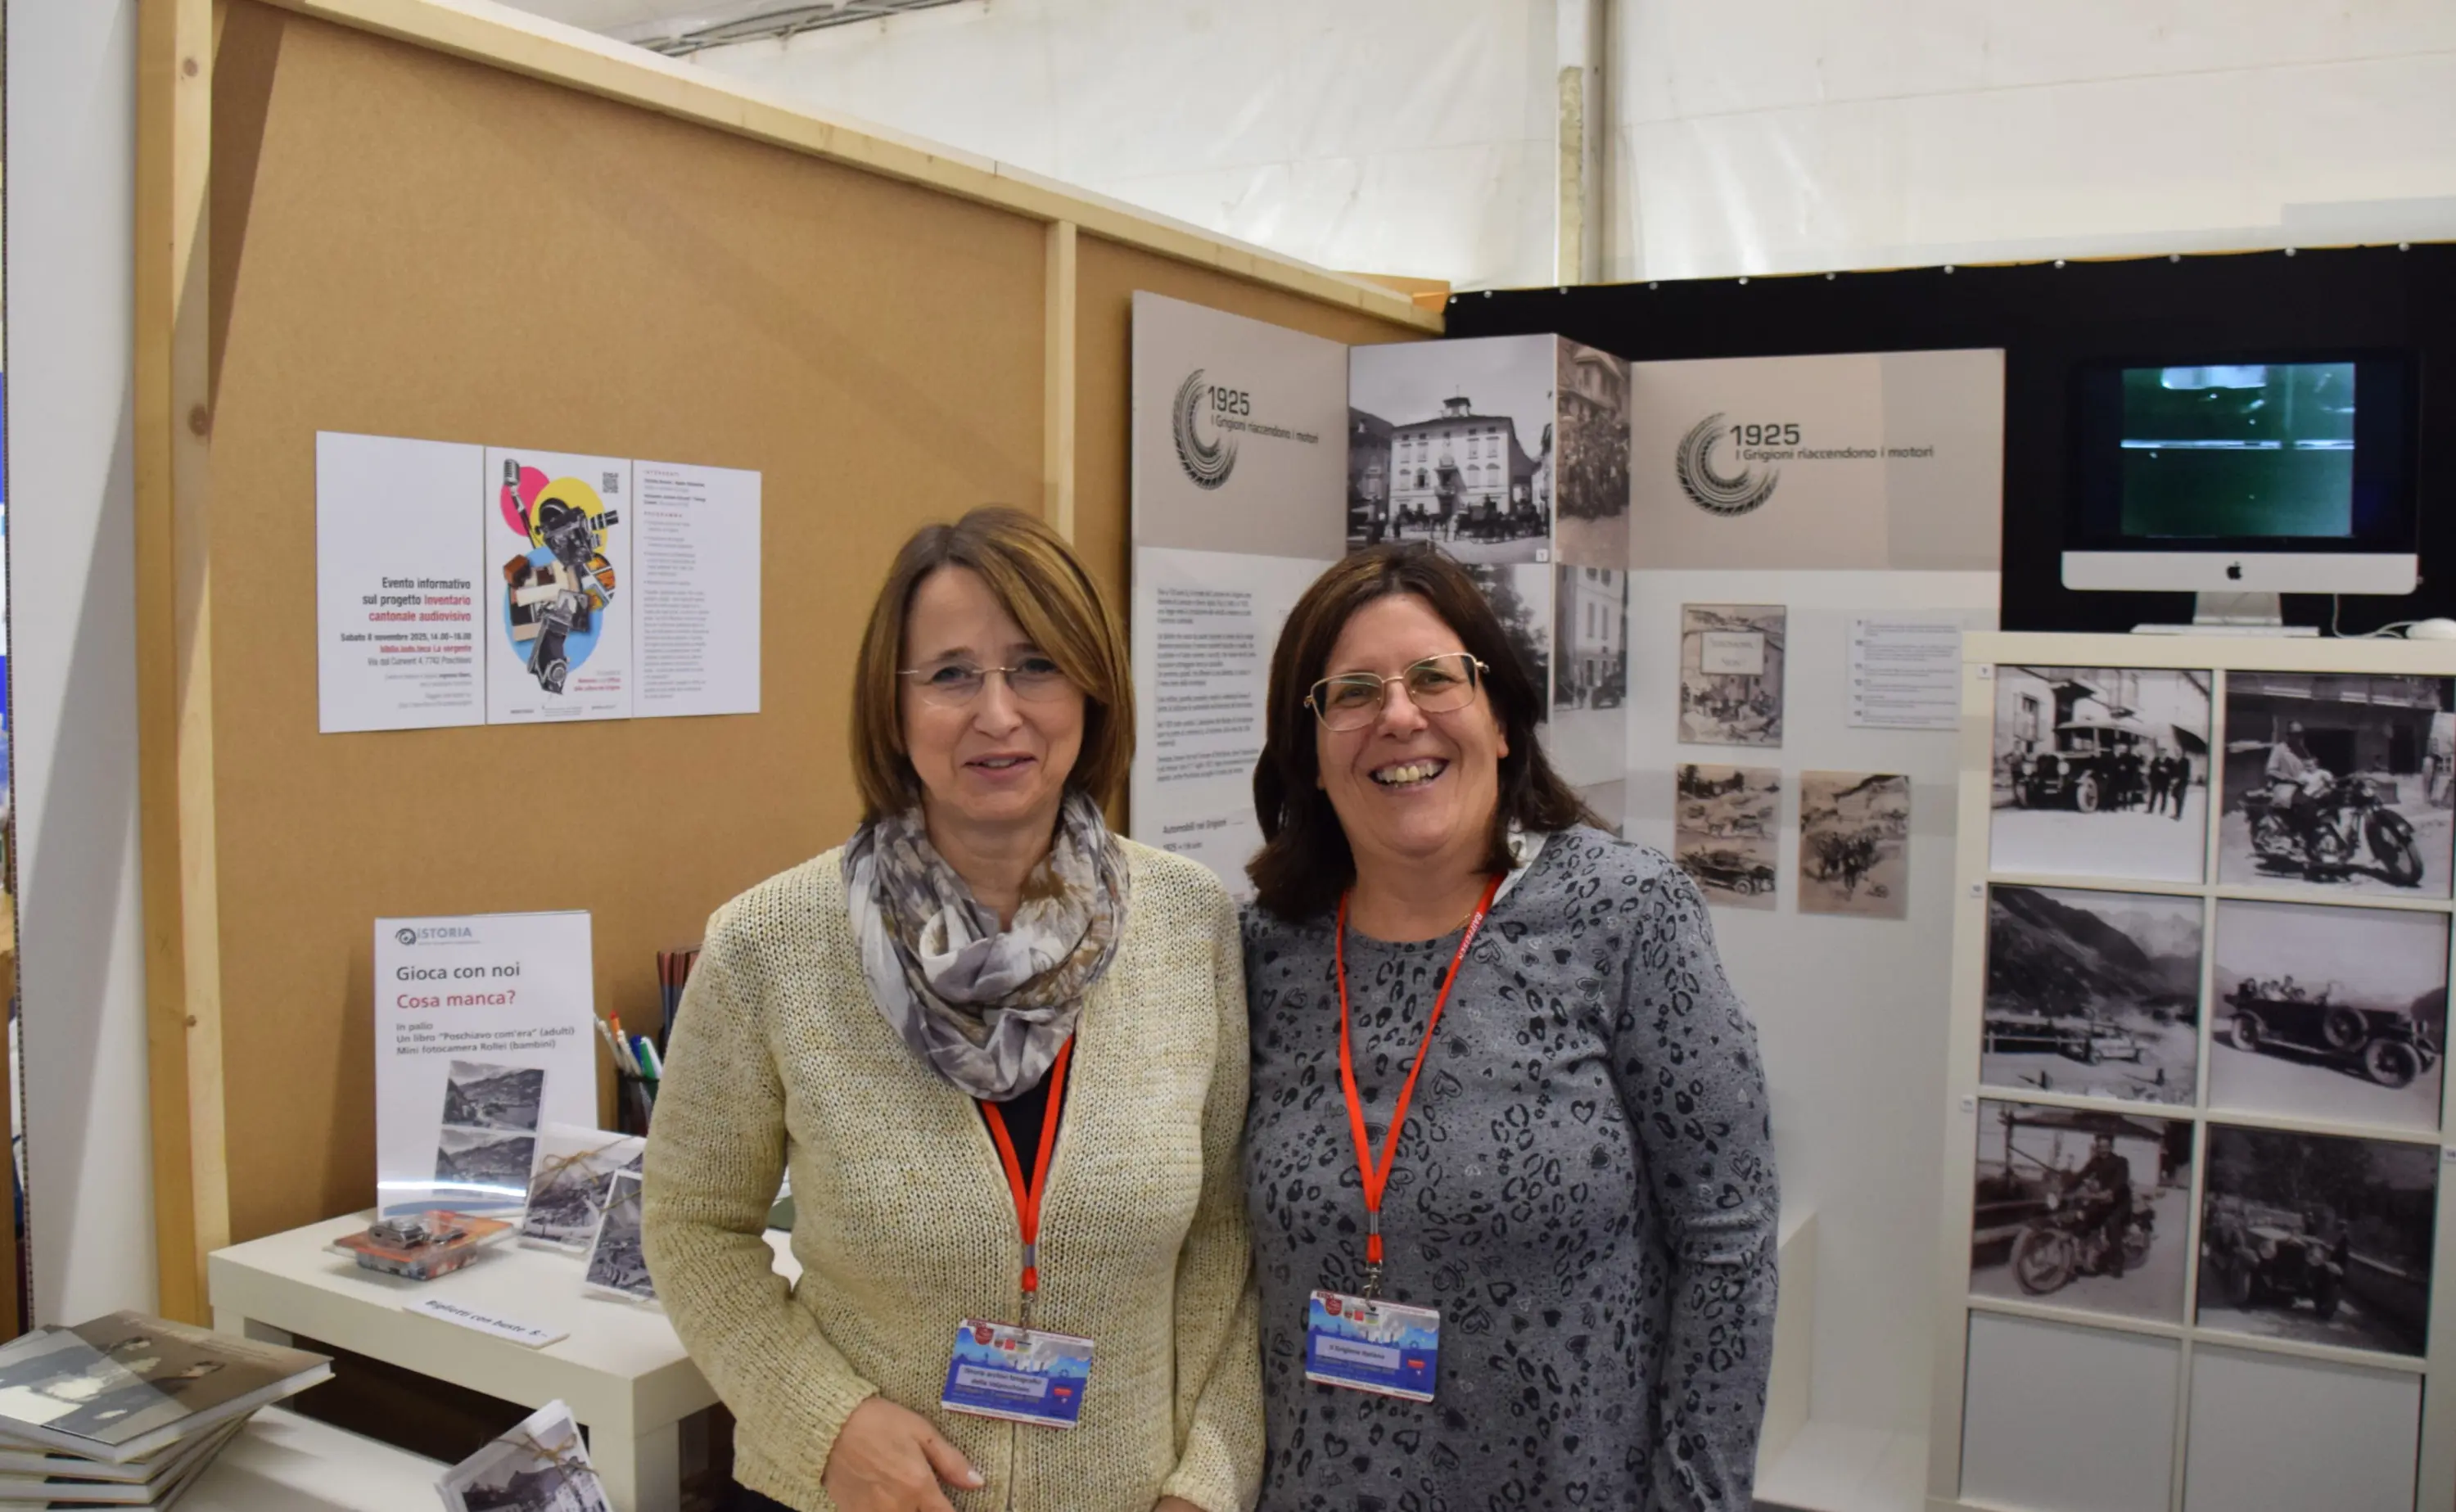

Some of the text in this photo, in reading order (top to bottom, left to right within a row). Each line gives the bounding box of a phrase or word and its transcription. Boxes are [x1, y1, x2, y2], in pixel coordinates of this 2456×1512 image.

[1208, 386, 1250, 416] 1925
[1216, 414, 1246, 432] Grigioni
[1248, 422, 1291, 440] riaccendono
[1297, 431, 1320, 445] motori
[1730, 423, 1800, 446] 1925
[1743, 448, 1794, 463] Grigioni
[1797, 446, 1877, 459] riaccendono
[1888, 445, 1934, 458] motori
[382, 576, 471, 589] Evento informativo
[362, 594, 377, 605] sul
[380, 594, 422, 607] progetto
[368, 611, 472, 622] cantonale audiovisivo
[341, 633, 365, 642] Sabato
[374, 633, 408, 641] novembre
[410, 632, 429, 642] 2025,
[396, 962, 520, 981] Gioca con noi
[396, 990, 516, 1009] Cosa manca?
[396, 1035, 410, 1043] Un
[413, 1033, 436, 1042] libro
[540, 1026, 575, 1036] (adulti)
[409, 1022, 433, 1032] palio
[396, 1039, 556, 1054] Mini fotocamera Rollei (bambini)
